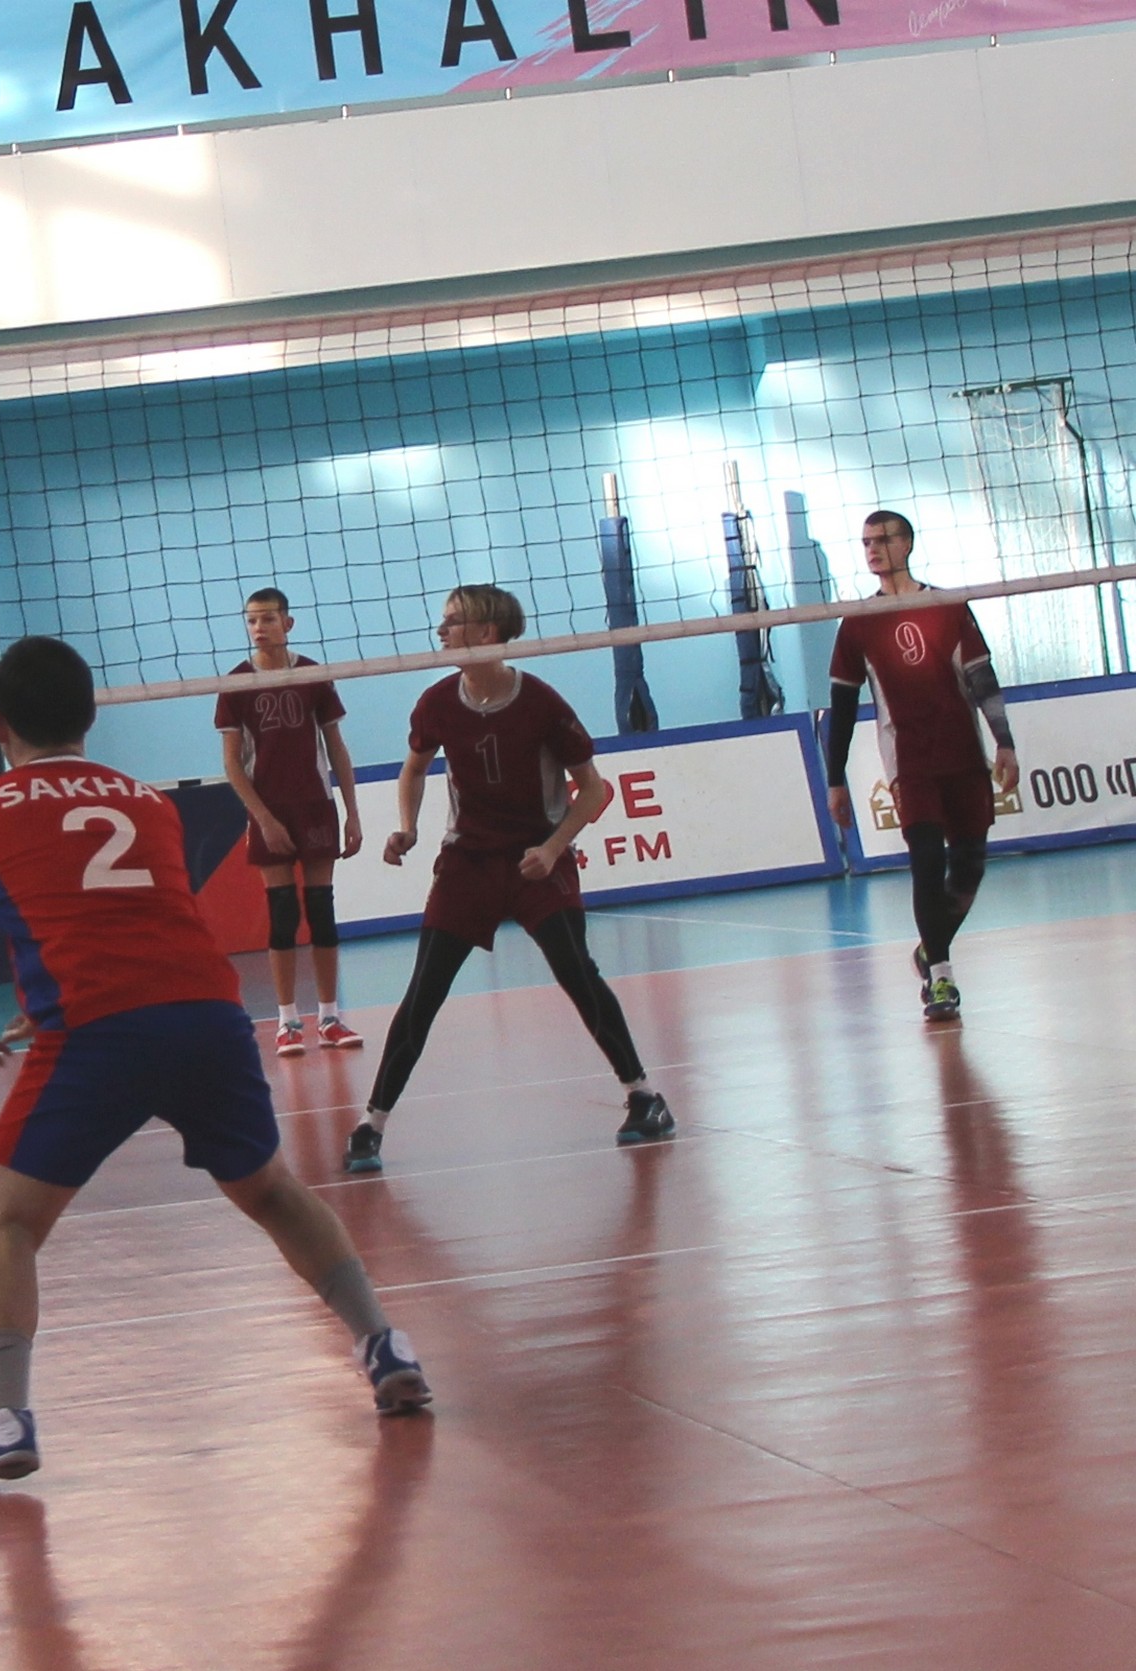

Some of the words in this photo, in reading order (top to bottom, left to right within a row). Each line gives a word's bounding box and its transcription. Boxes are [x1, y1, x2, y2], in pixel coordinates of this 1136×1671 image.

[895, 621, 926, 665] 9
[255, 690, 304, 732] 20
[475, 734, 502, 784] 1
[1030, 763, 1098, 809] ООО
[62, 805, 155, 890] 2
[604, 831, 672, 866] FM
